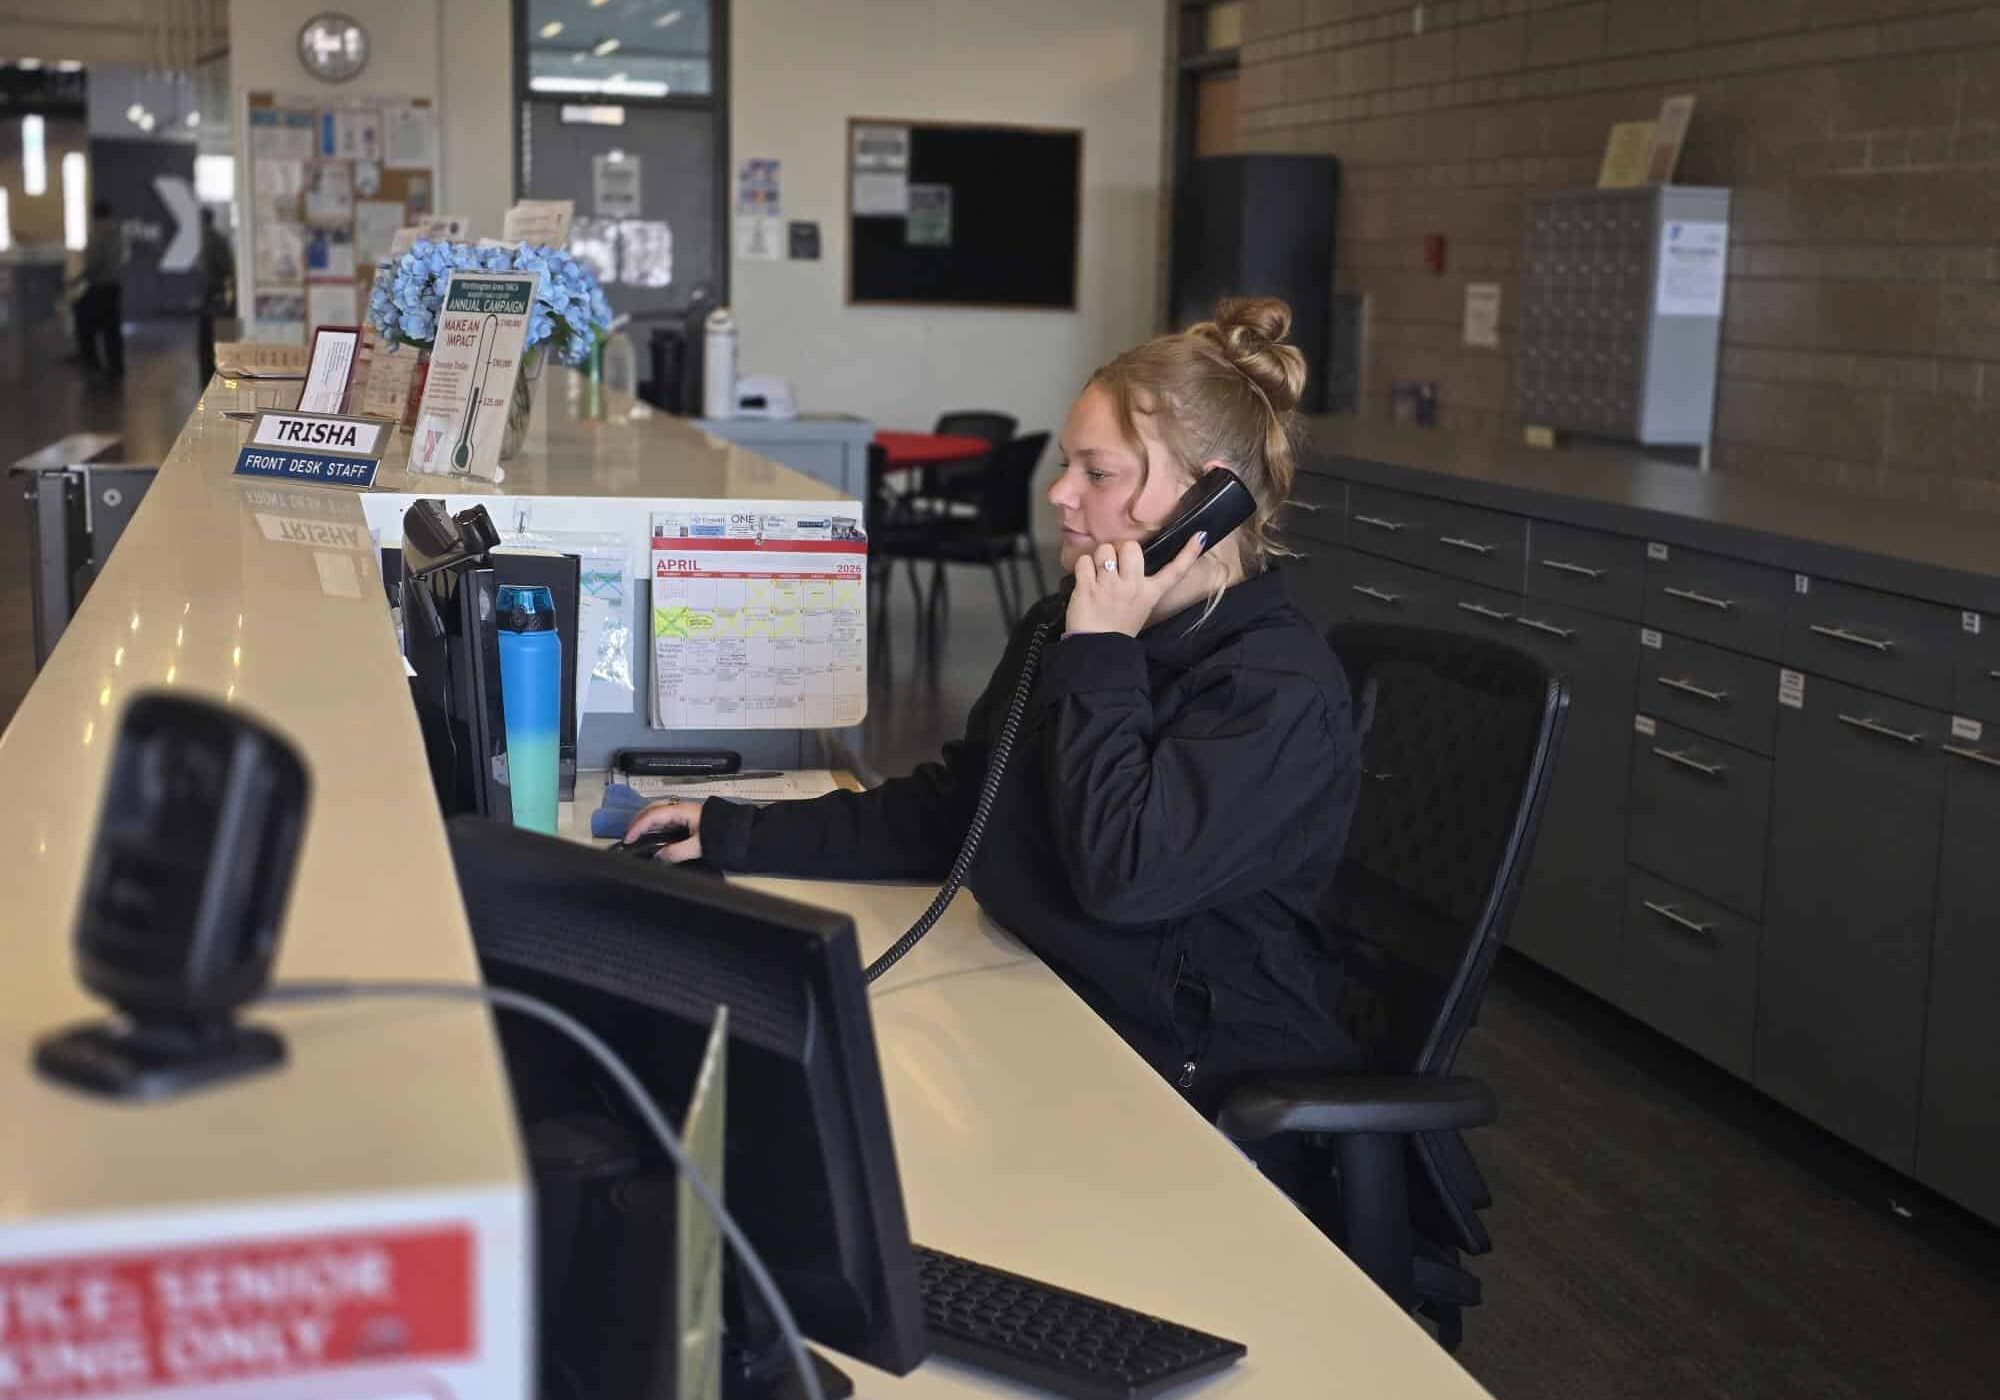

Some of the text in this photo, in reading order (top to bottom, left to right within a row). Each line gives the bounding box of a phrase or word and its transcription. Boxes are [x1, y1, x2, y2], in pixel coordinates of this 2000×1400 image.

[449, 298, 525, 313] ANNUAL CAMPAIGN
[444, 317, 480, 332] MAKE AN
[447, 335, 477, 347] IMPACT
[276, 420, 357, 446] TRISHA
[245, 454, 368, 479] FRONT DESK STAFF
[731, 513, 755, 524] ONE
[656, 558, 702, 571] APRIL
[152, 1253, 391, 1313] SENIOR
